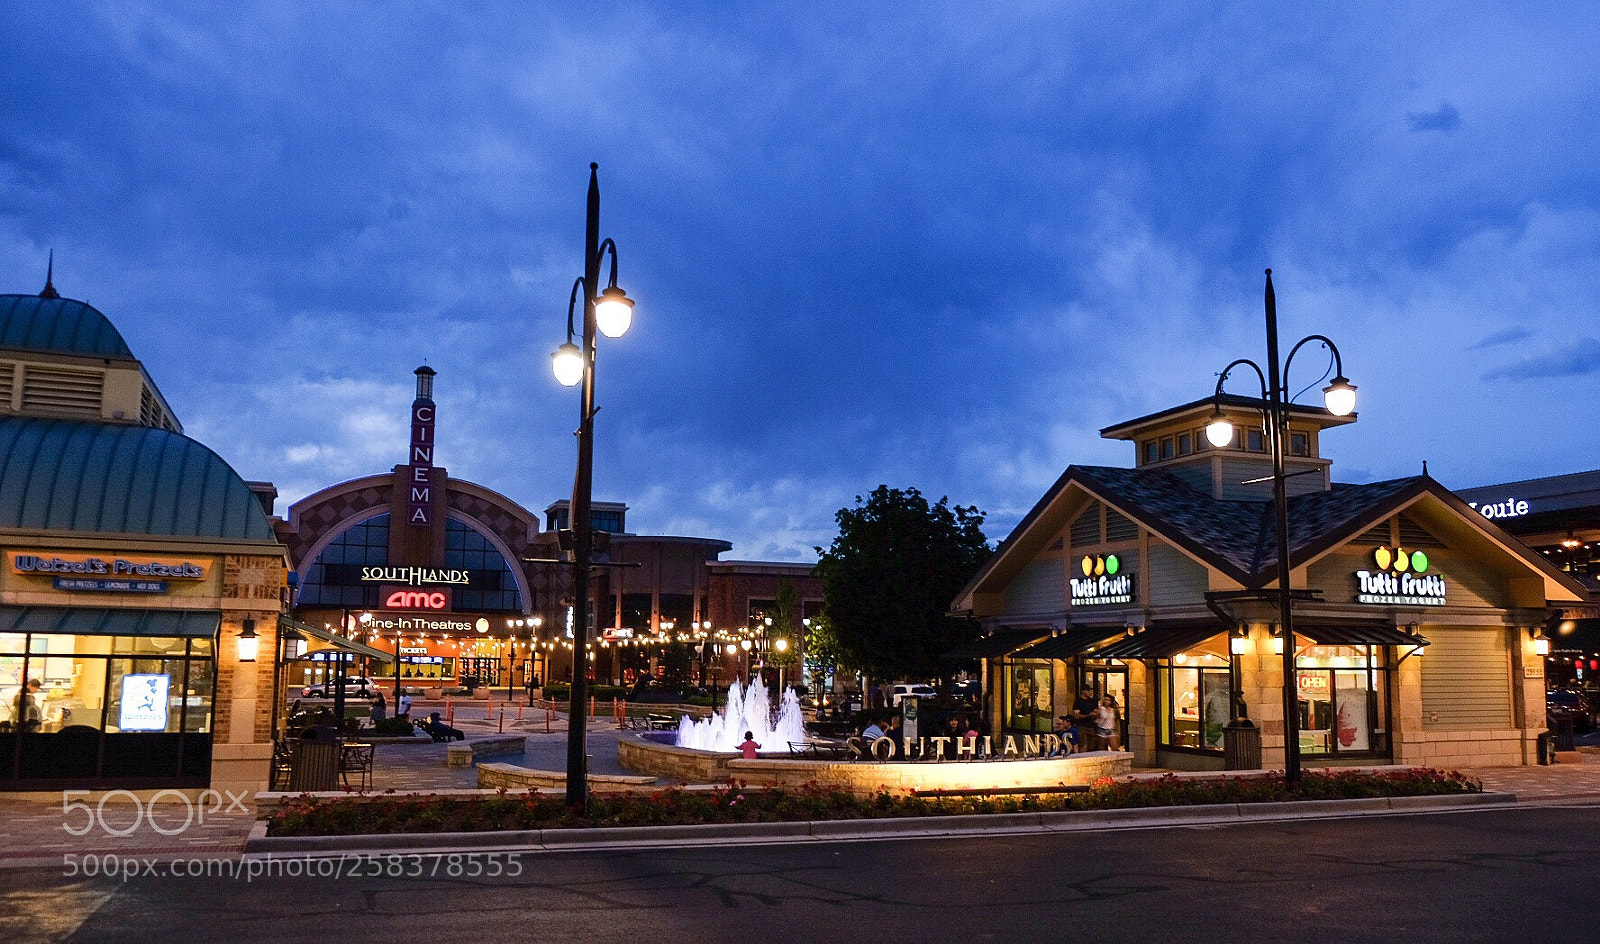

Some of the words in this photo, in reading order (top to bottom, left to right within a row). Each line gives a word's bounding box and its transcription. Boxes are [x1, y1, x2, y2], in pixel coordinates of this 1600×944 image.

[411, 407, 432, 523] CINEMA
[1468, 498, 1529, 519] ouie
[15, 555, 108, 574] Wetzel's
[113, 559, 203, 578] Pretzels
[361, 566, 469, 585] SOUTHLANDS
[1069, 576, 1097, 597] Tutti
[1357, 570, 1398, 594] Tutti
[1101, 595, 1131, 604] YOGURT
[1359, 595, 1400, 603] FROZEN
[1404, 597, 1446, 605] YOGURT
[412, 618, 472, 630] Theatres
[1301, 677, 1326, 688] OPEN
[846, 732, 1074, 762] SOUTHLANDS
